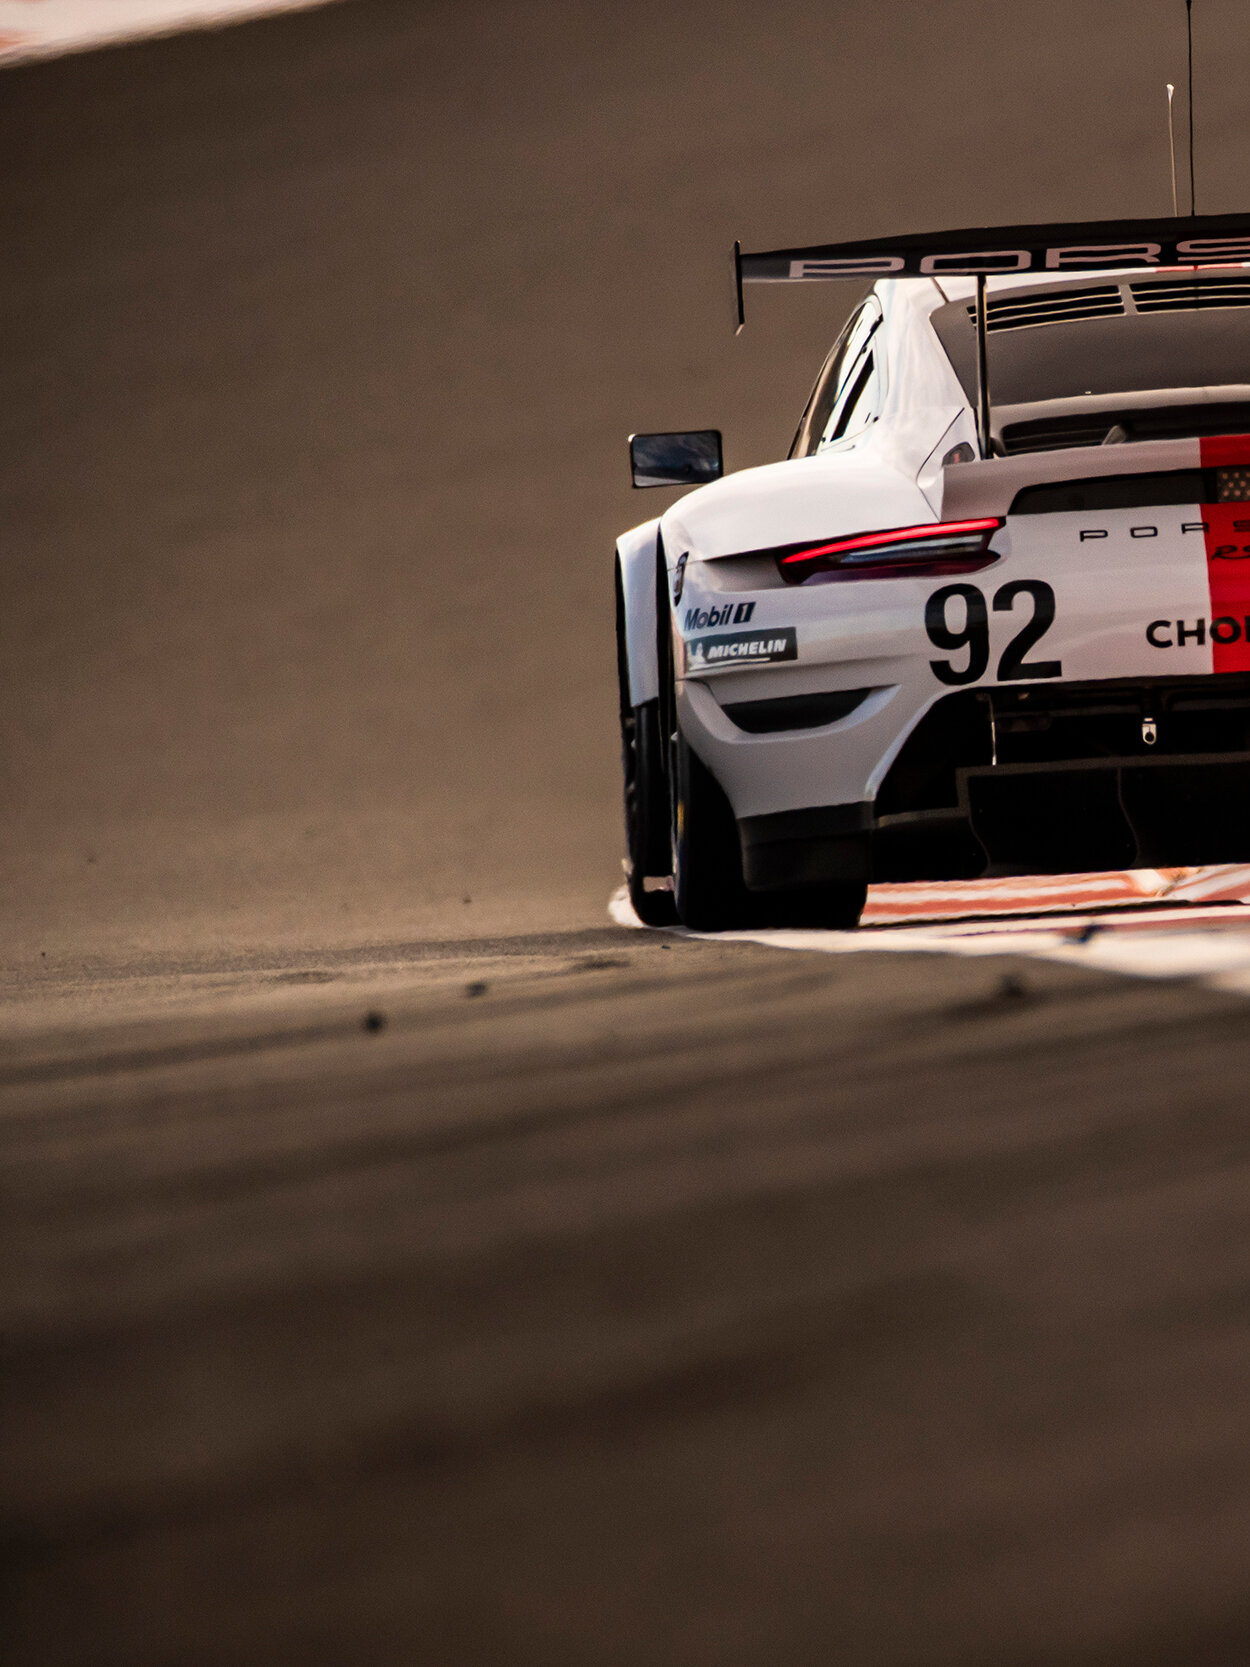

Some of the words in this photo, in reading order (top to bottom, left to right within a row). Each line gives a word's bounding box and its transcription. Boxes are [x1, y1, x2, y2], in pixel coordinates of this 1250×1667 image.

[684, 603, 734, 631] Mobil
[924, 579, 1062, 686] 92
[707, 638, 787, 660] MICHELIN
